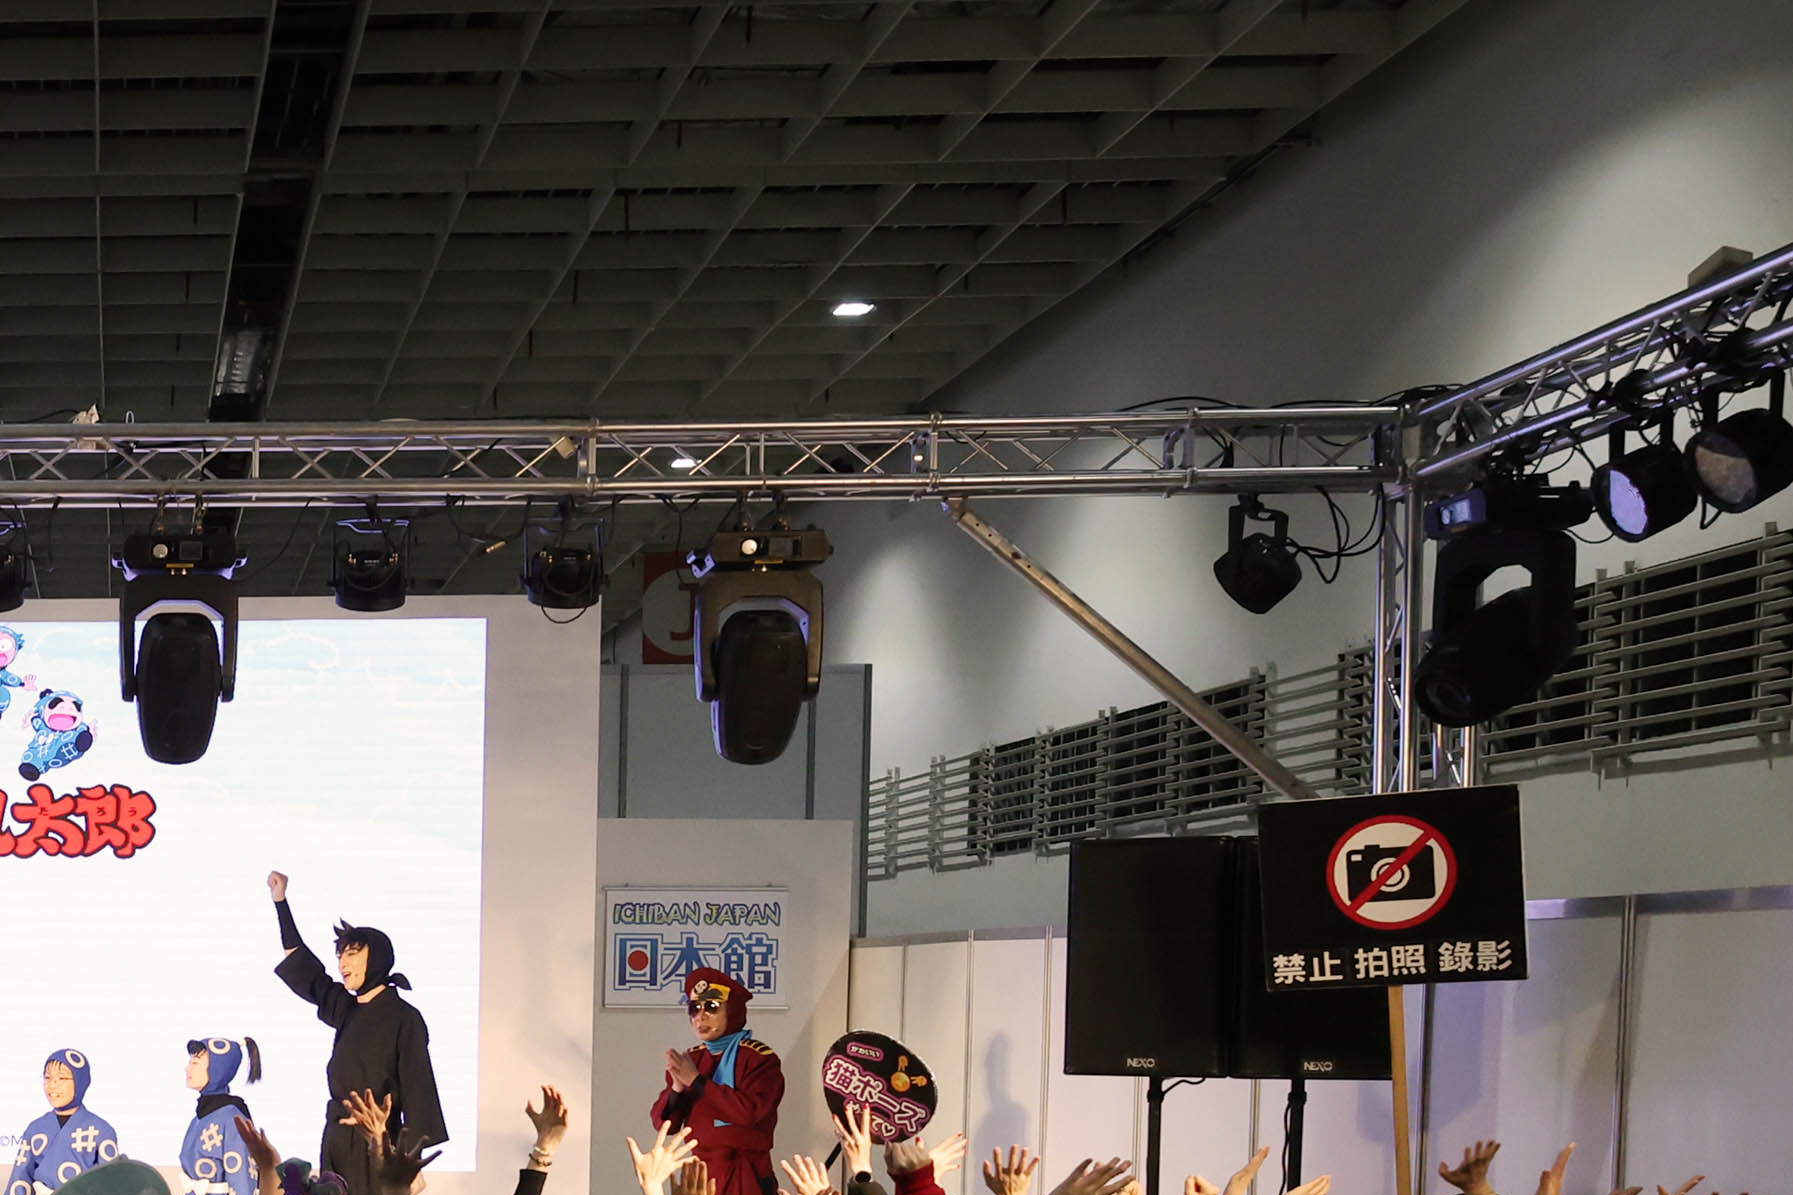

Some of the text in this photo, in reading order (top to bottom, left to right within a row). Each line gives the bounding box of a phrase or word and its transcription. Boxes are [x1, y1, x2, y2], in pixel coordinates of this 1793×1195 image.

[613, 902, 781, 926] ICHIBAN JAPAN
[613, 932, 779, 995] 日本館
[1273, 940, 1512, 985] 禁止 拍照 錄影
[1127, 1057, 1155, 1068] NEXO
[1304, 1061, 1333, 1072] NEXO
[825, 1058, 927, 1132] 猫ポーズ
